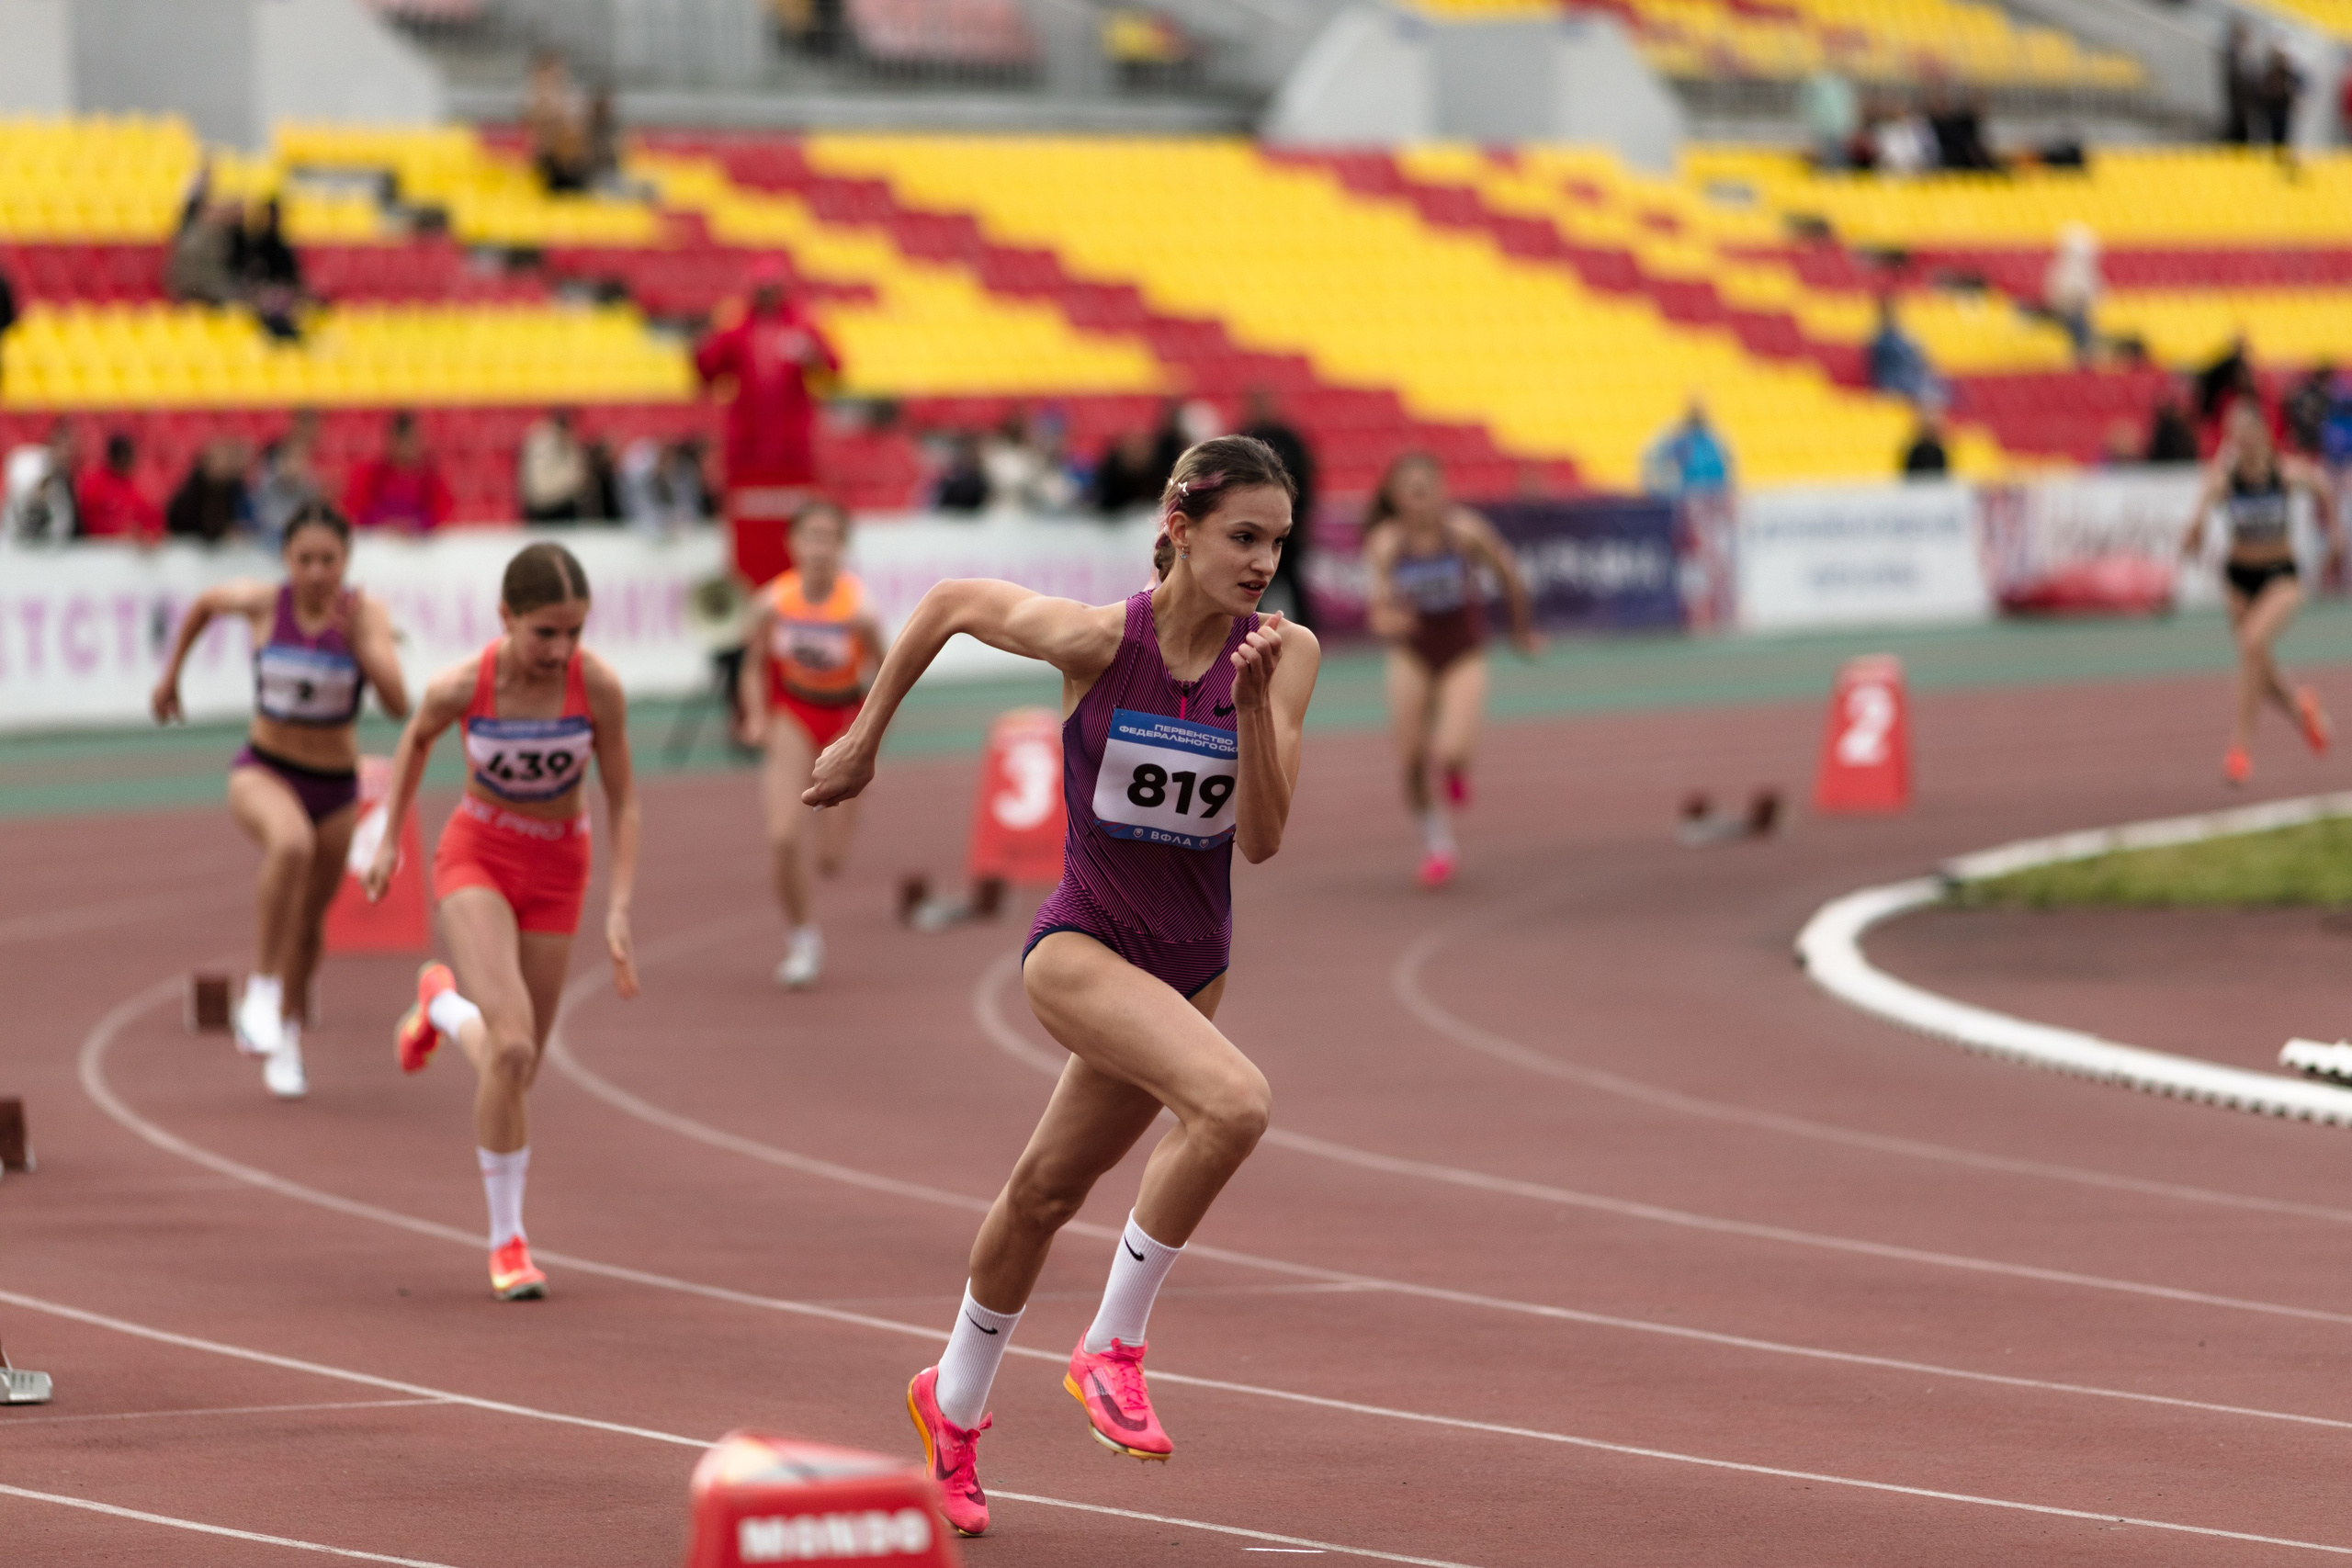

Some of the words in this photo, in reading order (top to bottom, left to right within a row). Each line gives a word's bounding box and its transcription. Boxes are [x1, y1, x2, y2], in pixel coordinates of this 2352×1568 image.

[1119, 725, 1217, 750] ФЕДЕРАЛЬНОГО
[1154, 724, 1234, 746] ПЕРВЕНСТВО
[1837, 688, 1893, 765] 2
[487, 750, 573, 781] 439
[992, 740, 1055, 829] 3
[1127, 763, 1236, 818] 819
[1150, 830, 1192, 846] ВФЛА
[738, 1509, 933, 1563] MONDO
